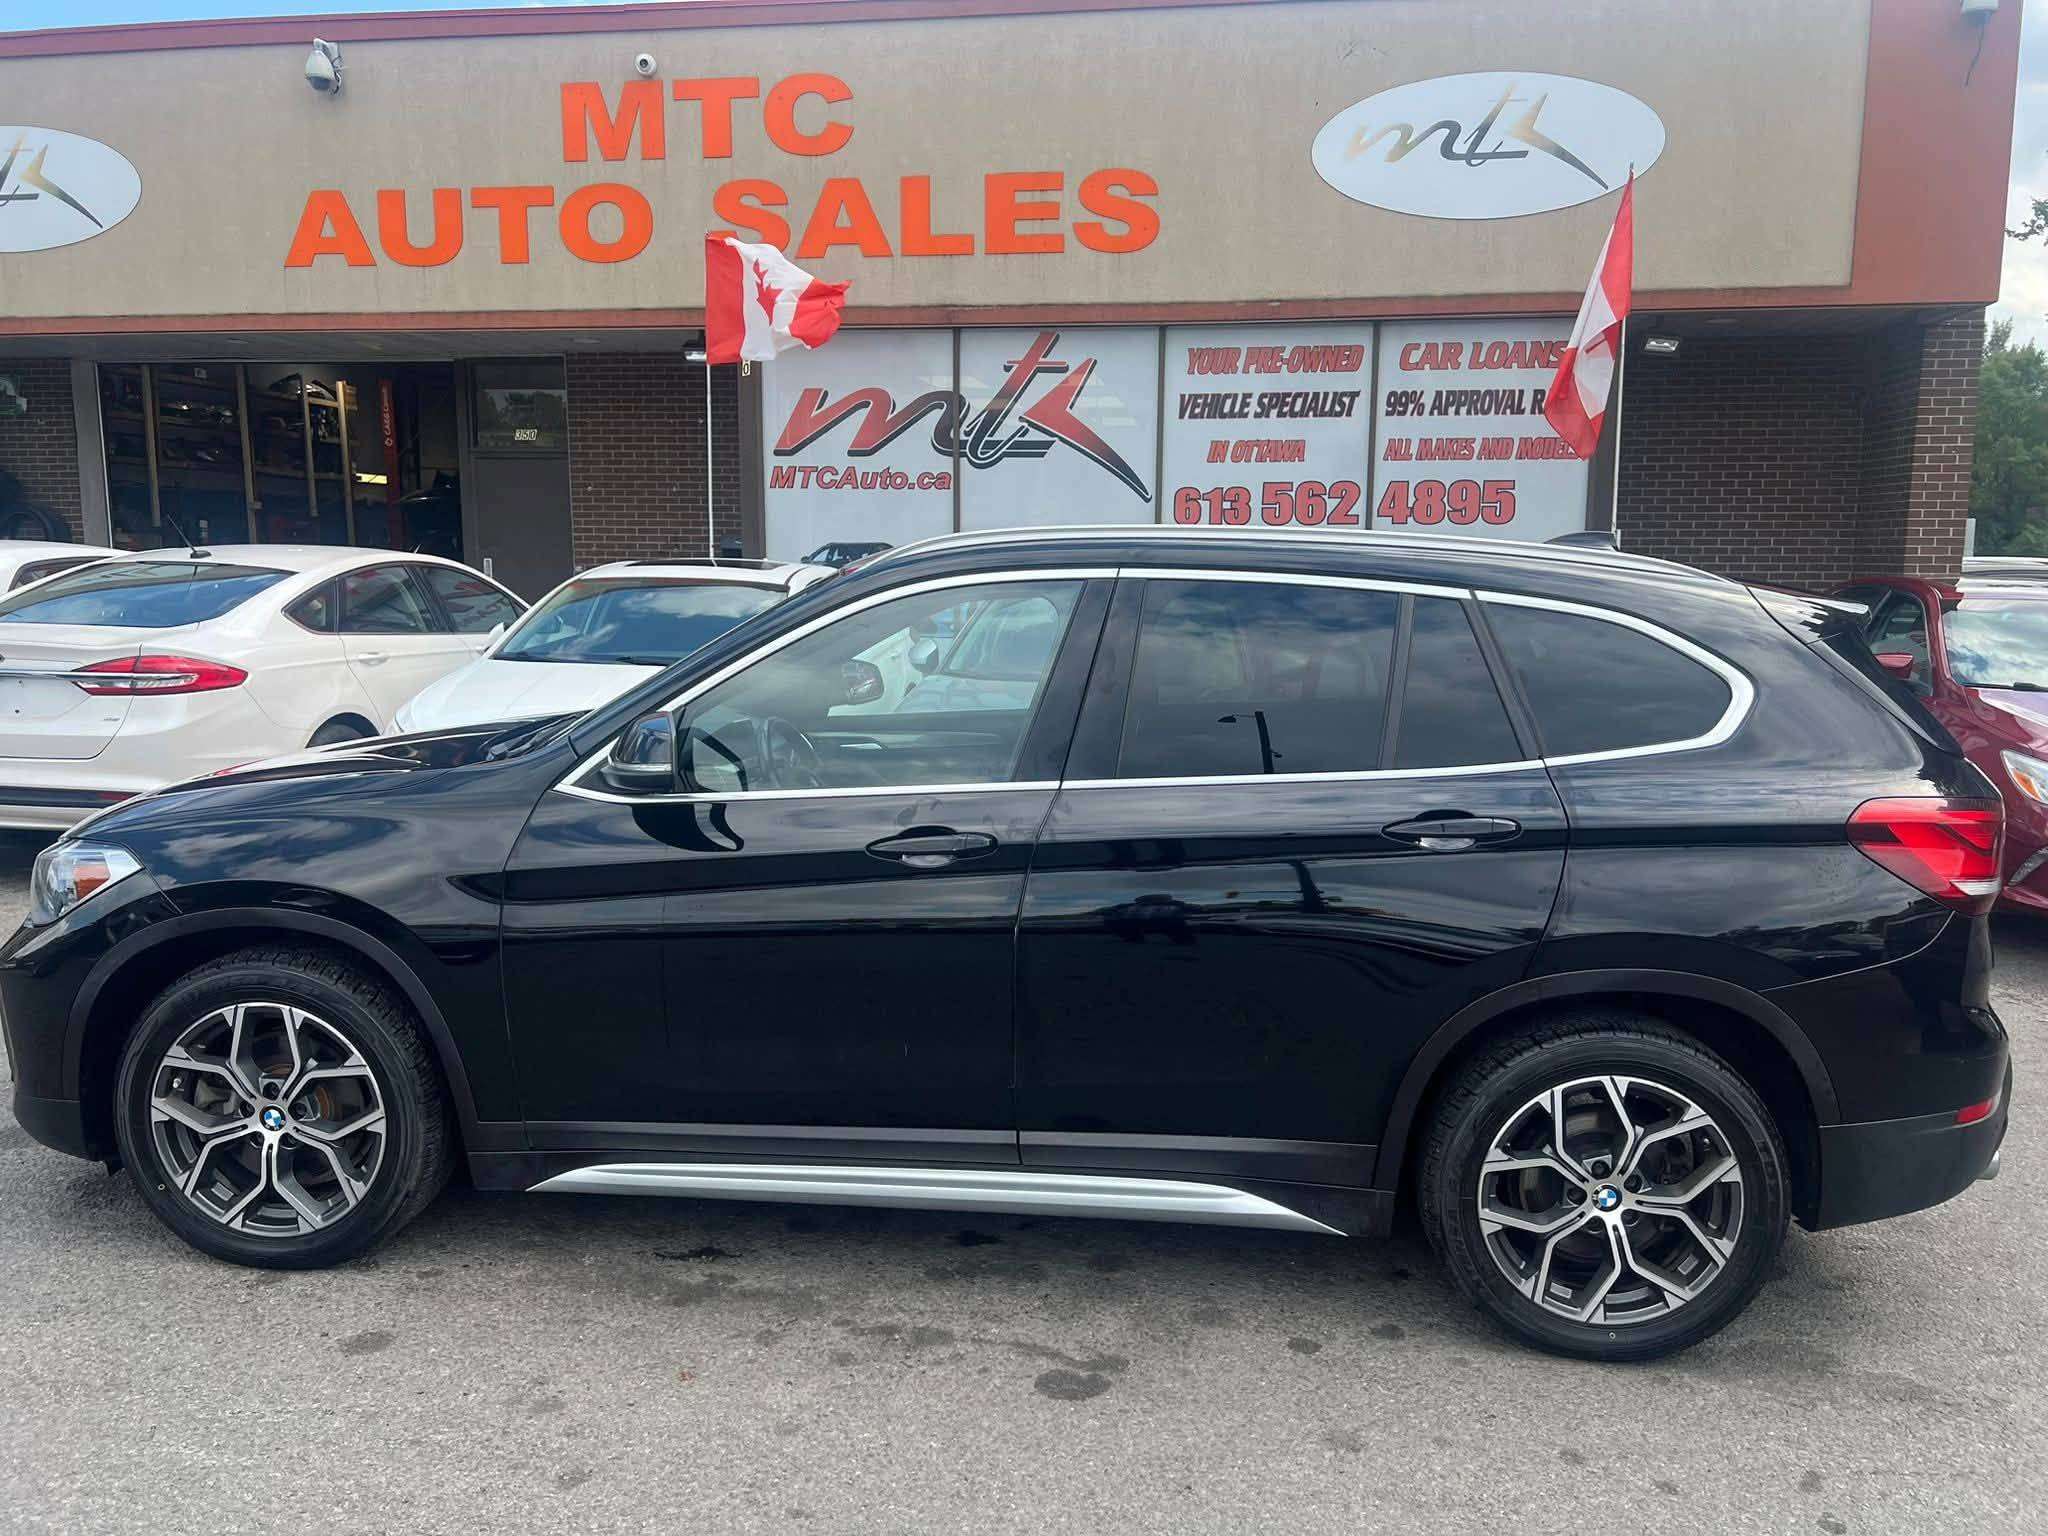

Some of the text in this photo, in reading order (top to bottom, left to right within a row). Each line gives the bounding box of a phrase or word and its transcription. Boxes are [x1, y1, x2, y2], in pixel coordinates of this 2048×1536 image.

[561, 73, 854, 162] MTC
[285, 169, 1160, 267] AUTO SALES
[1187, 345, 1365, 375] YOUR PRE-OWNED
[1399, 341, 1569, 371] CAR LOANS
[1178, 391, 1361, 419] VEHICLE SPECIALIST
[1385, 391, 1425, 416] 99%
[1429, 390, 1526, 416] APPROVAL
[1206, 440, 1306, 463] IN OTTAWA
[1383, 439, 1413, 461] ALL
[1415, 438, 1476, 461] MAKES
[1476, 437, 1514, 460] AND
[769, 466, 953, 490] MTCAuto.ca
[1173, 480, 1361, 526] 613 562
[1377, 479, 1516, 525] 4895
